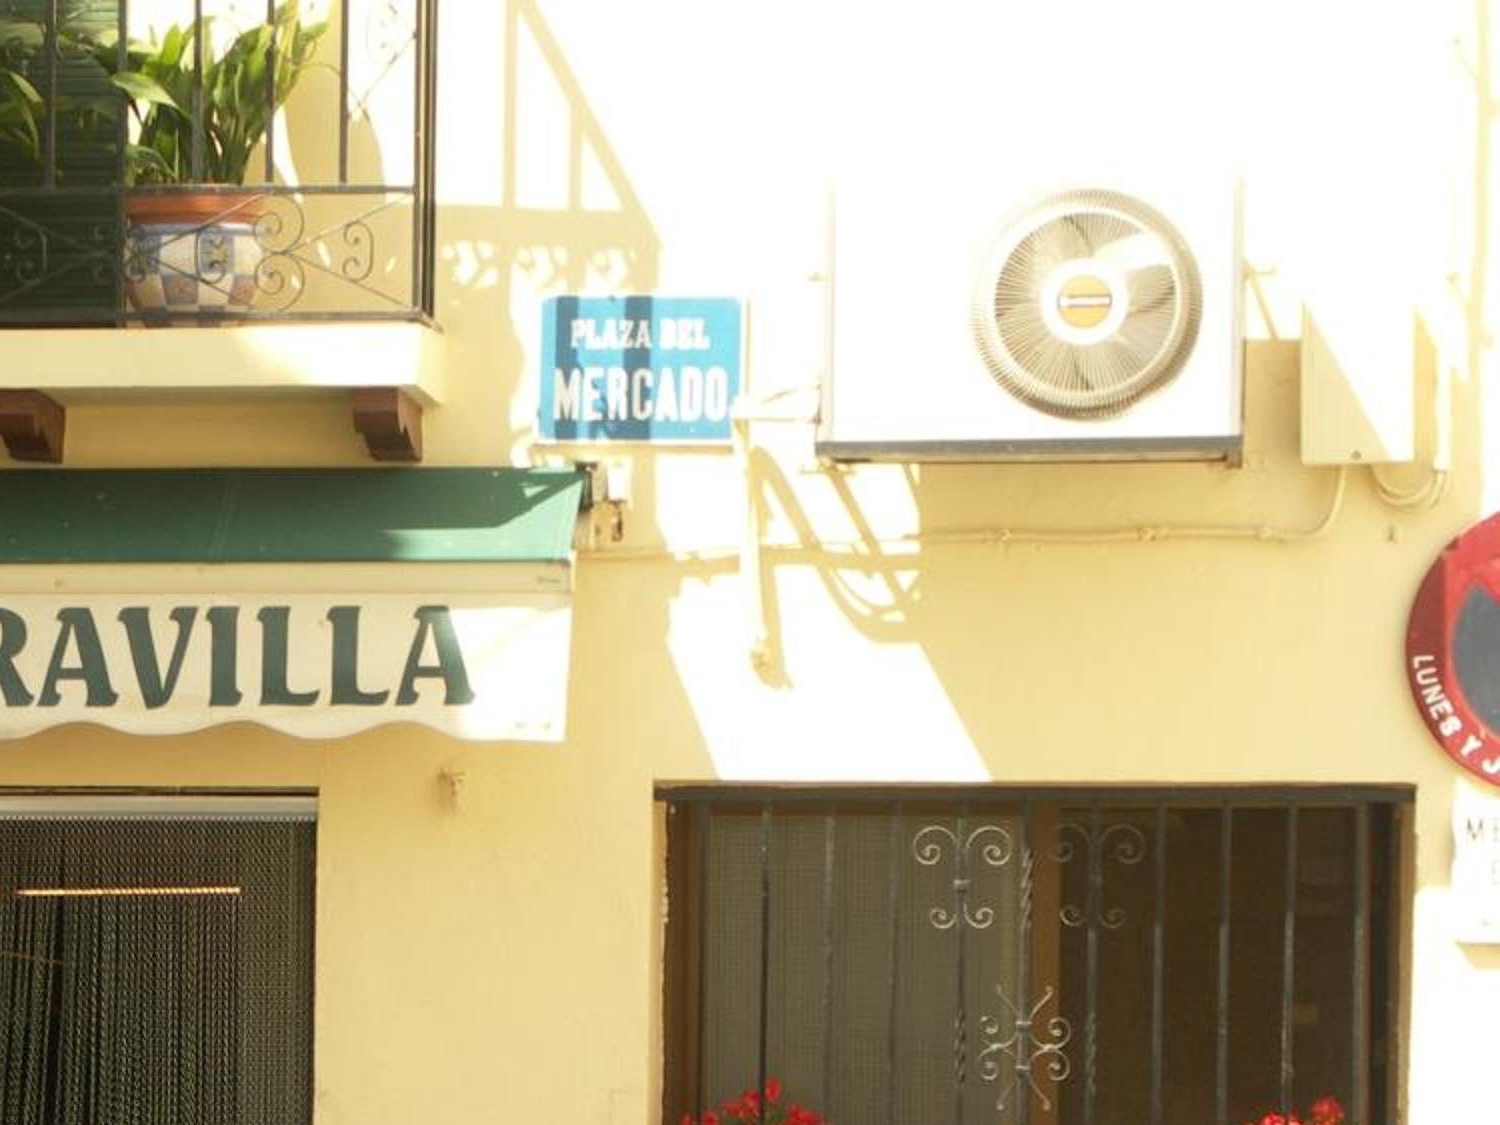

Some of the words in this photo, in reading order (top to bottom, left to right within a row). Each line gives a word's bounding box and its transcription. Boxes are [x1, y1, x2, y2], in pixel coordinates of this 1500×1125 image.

[570, 318, 652, 350] PLAZA
[659, 317, 711, 350] DEL
[553, 366, 729, 422] MERCADO
[1411, 653, 1462, 737] LUNES
[1460, 734, 1483, 757] Y
